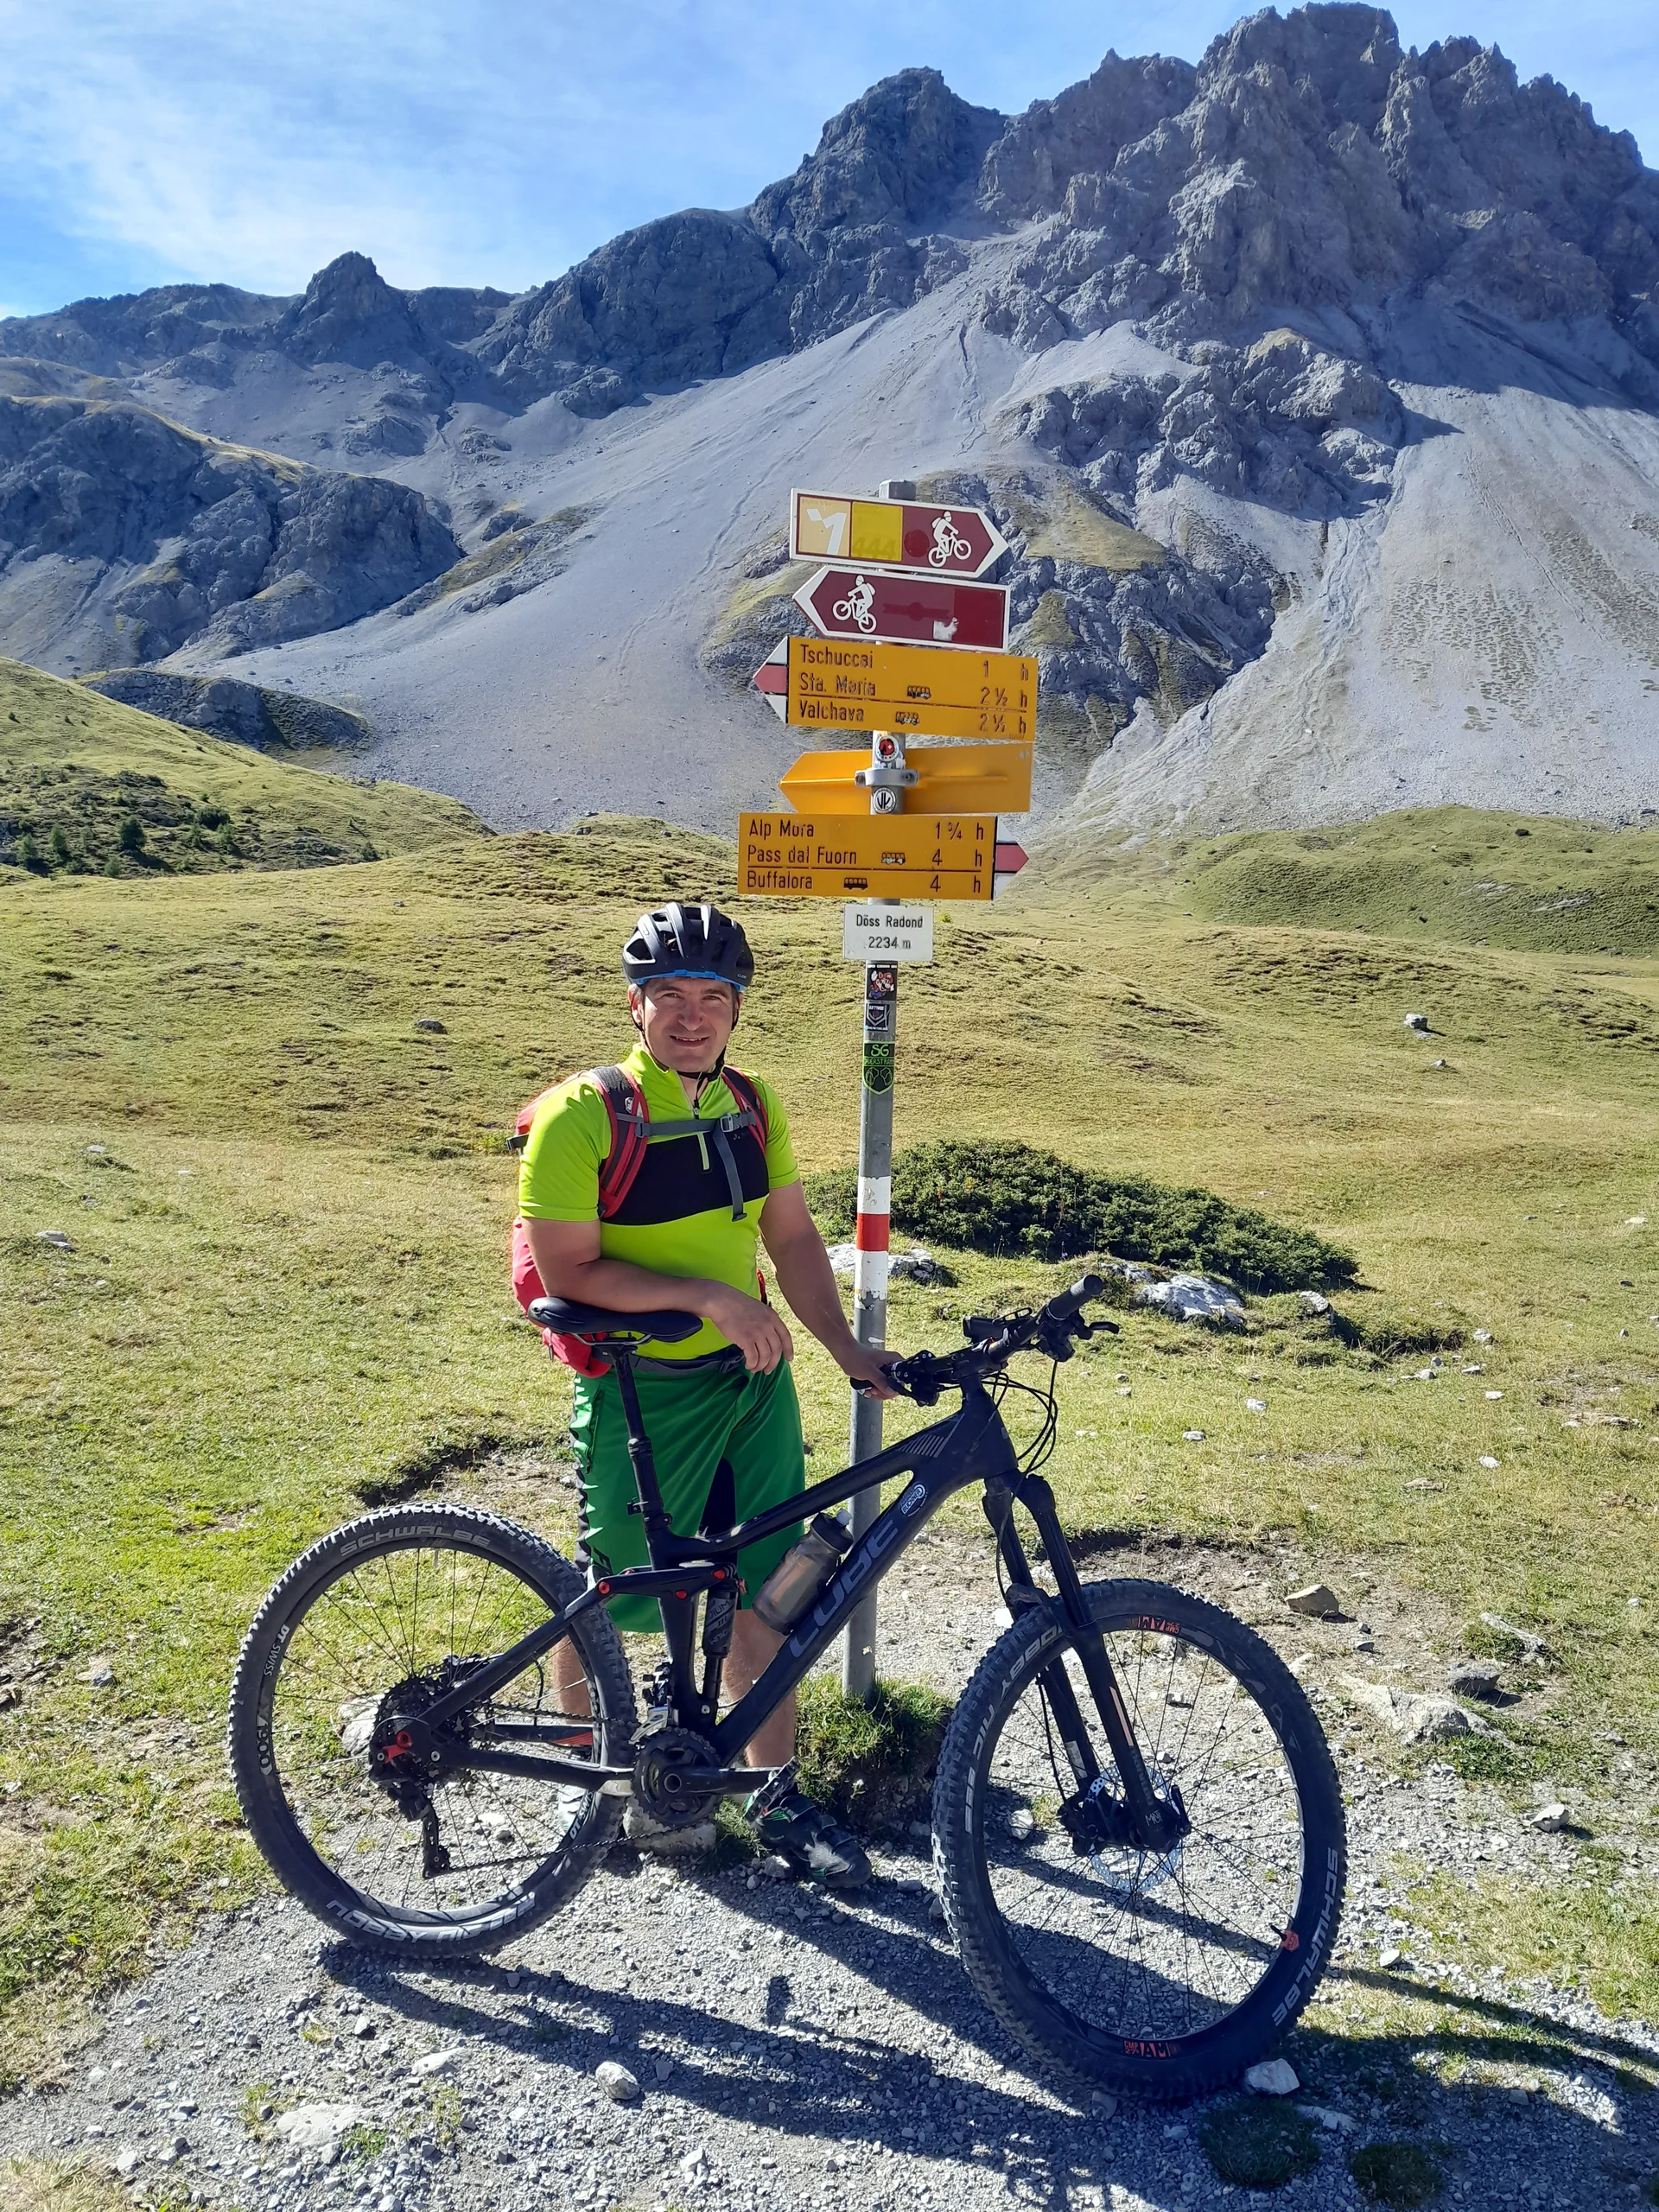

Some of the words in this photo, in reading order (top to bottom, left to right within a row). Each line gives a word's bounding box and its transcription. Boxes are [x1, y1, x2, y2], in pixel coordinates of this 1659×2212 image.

[800, 644, 874, 670] Tschuccai
[982, 660, 989, 678] 1
[1020, 663, 1029, 682] h
[799, 672, 827, 693] Sta.
[836, 675, 876, 696] Maria
[1020, 690, 1028, 708] h
[798, 700, 865, 721] Valchava
[1019, 716, 1027, 734] h
[749, 818, 772, 841] Alp
[779, 819, 815, 839] Mora
[935, 823, 941, 841] 1
[976, 823, 984, 842] h
[747, 845, 782, 865] Pass
[788, 846, 810, 865] dal
[817, 847, 858, 866] Fuorn
[931, 849, 944, 867] 4
[975, 849, 982, 868] h
[747, 870, 813, 891] Buffalora
[930, 875, 942, 893] 4
[973, 875, 982, 894] h
[855, 913, 880, 928] Döss
[886, 914, 924, 930] Radond
[868, 936, 898, 950] 2234
[902, 939, 912, 950] m
[871, 1044, 890, 1057] SG
[340, 1525, 491, 1557] SCHWALBE
[789, 1518, 899, 1658] CUBE
[276, 1624, 291, 1643] DT
[264, 1643, 281, 1677] SWISS
[569, 1818, 581, 1840] DT
[325, 1899, 428, 1943] NOBBY
[1271, 1847, 1338, 2027] SCHWALBE
